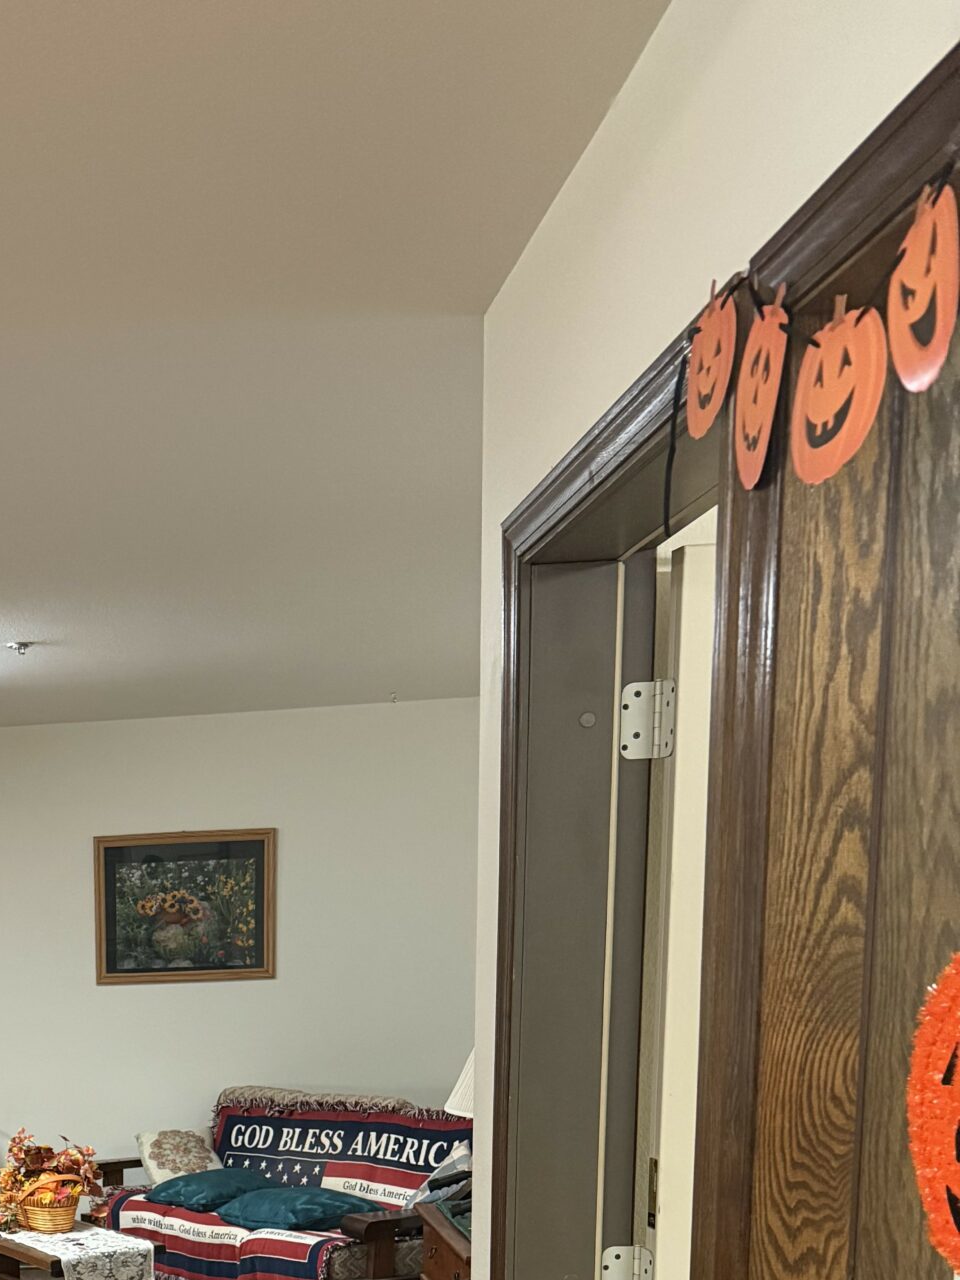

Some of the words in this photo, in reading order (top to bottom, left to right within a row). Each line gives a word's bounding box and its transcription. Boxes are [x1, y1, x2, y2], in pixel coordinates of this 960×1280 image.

[230, 1124, 274, 1148] GOD
[278, 1127, 345, 1154] BLESS
[347, 1131, 459, 1168] AMERIC
[343, 1180, 357, 1191] God
[358, 1182, 378, 1196] bless
[379, 1188, 410, 1201] Americ
[147, 1218, 163, 1229] with
[178, 1224, 192, 1235] God
[192, 1227, 207, 1238] bless
